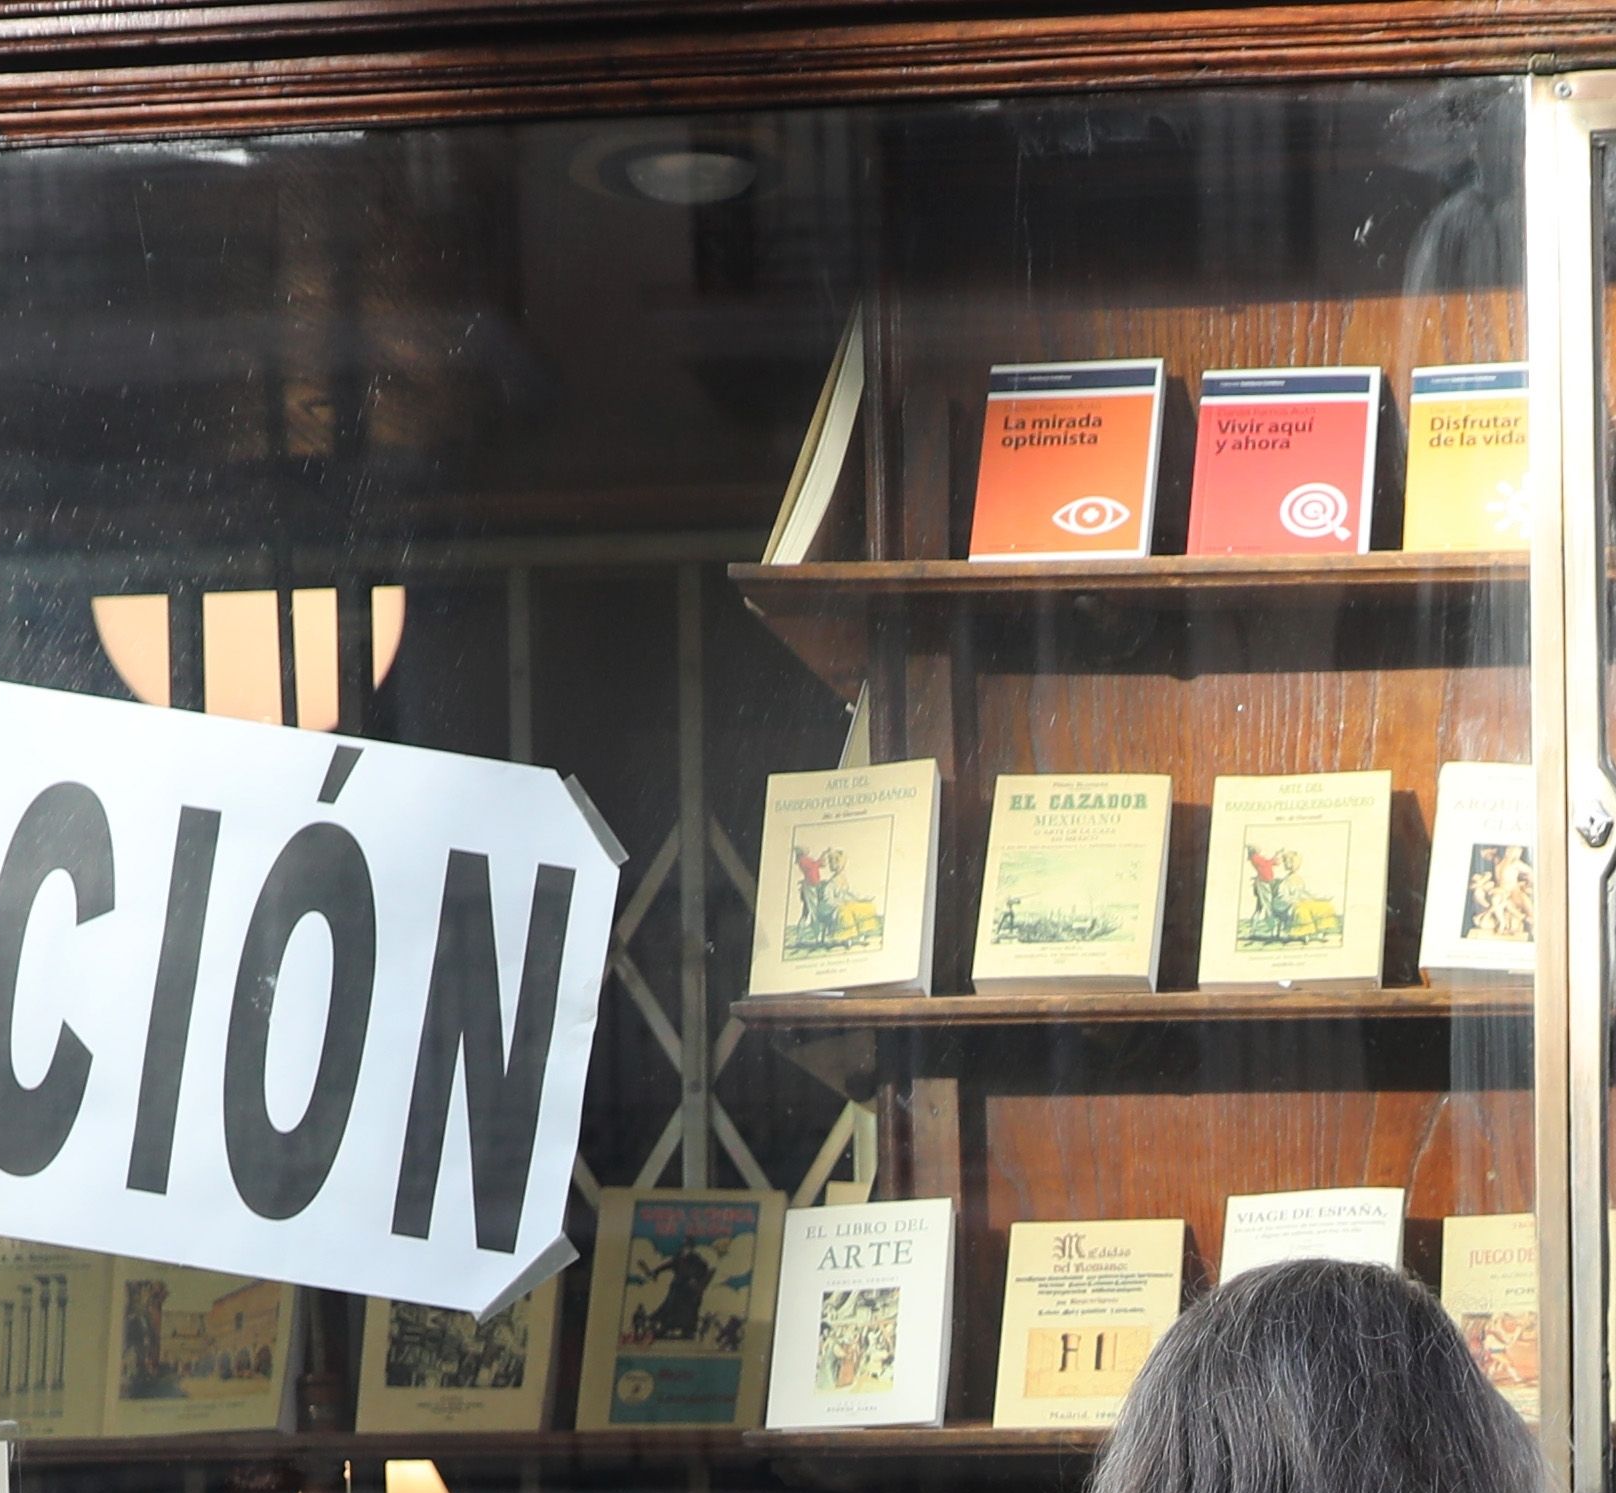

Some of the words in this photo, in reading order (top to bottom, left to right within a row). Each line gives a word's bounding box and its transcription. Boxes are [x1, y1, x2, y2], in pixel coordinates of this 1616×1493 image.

[1003, 415, 1027, 430] La
[1031, 413, 1103, 430] mirada
[1217, 418, 1264, 435] Vivir
[1268, 417, 1314, 438] aquí
[1429, 413, 1521, 432] Disfrutar
[1001, 428, 1100, 450] optimista
[1215, 438, 1226, 452] y
[1230, 434, 1291, 450] ahora
[1429, 433, 1448, 449] de
[1459, 433, 1477, 447] la
[1481, 430, 1526, 447] vida
[1009, 794, 1037, 811] EL
[1049, 793, 1148, 811] CAZADOR
[1033, 814, 1122, 827] MEXICANO
[1237, 1209, 1285, 1225] VIAGE
[1292, 1208, 1314, 1221] DE
[805, 1226, 828, 1240] EL
[835, 1221, 887, 1237] LIBRO
[894, 1217, 929, 1233] DEL
[815, 1240, 914, 1271] ARTE
[1469, 1249, 1514, 1268] JUEGO
